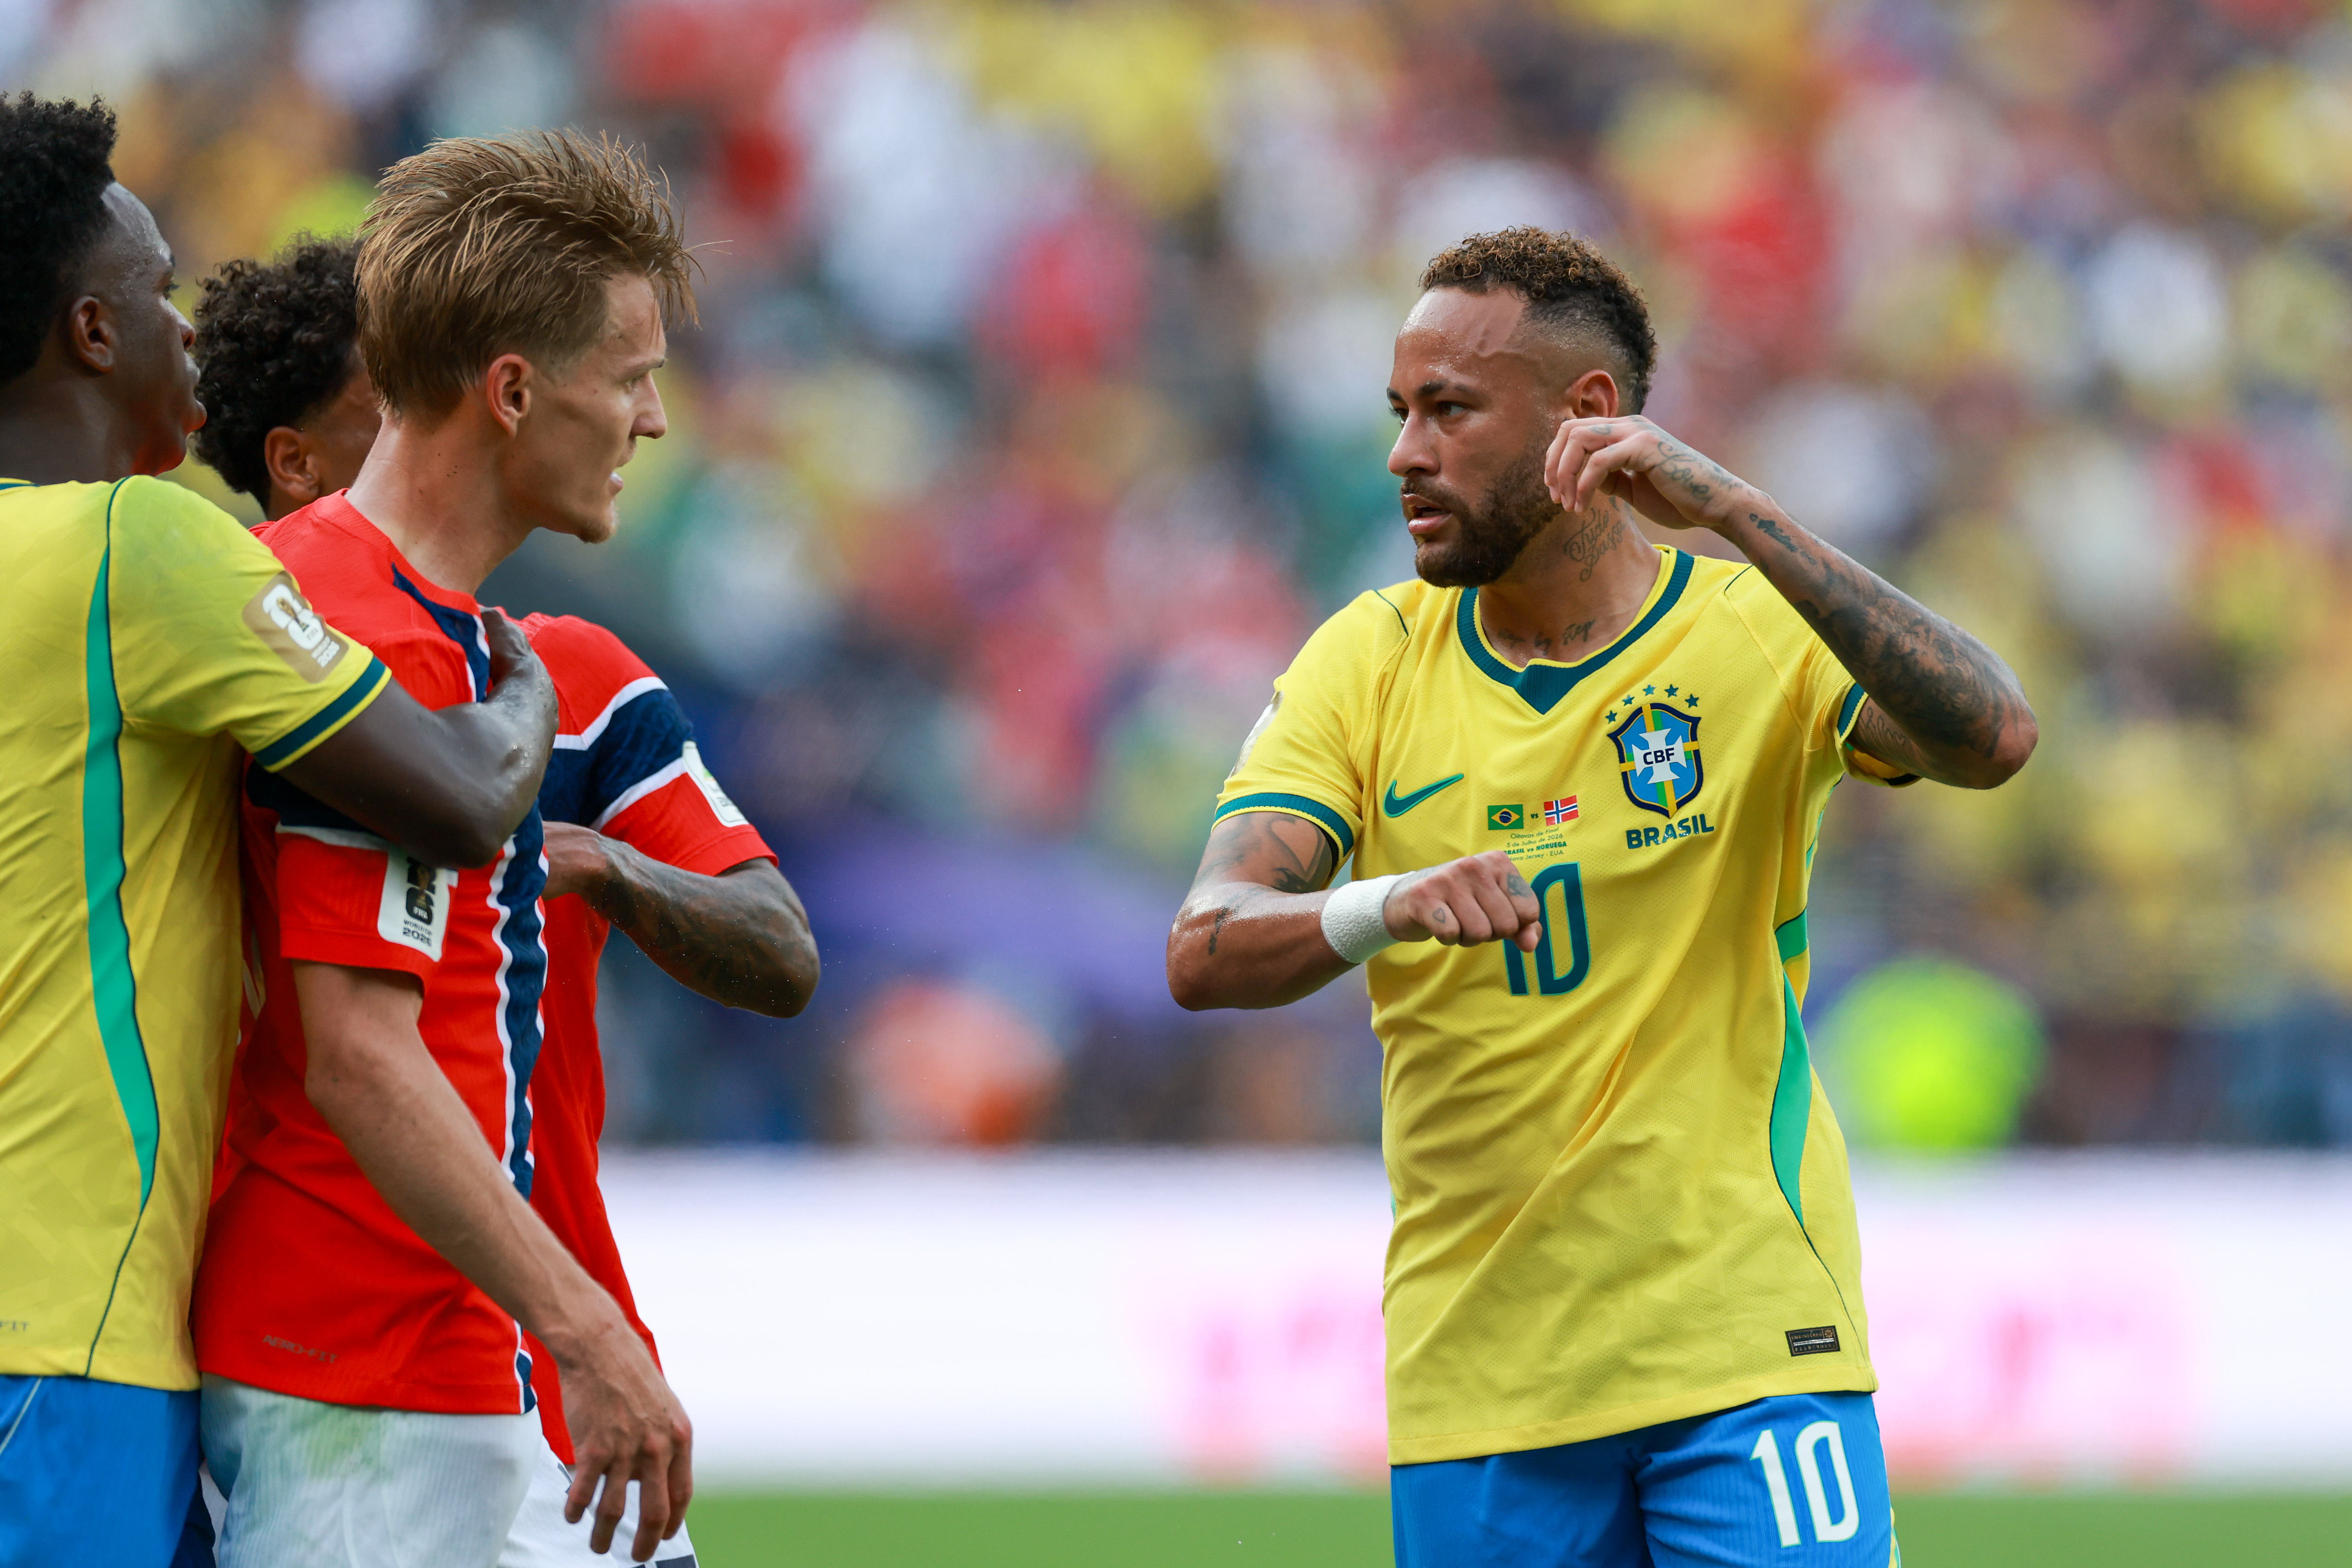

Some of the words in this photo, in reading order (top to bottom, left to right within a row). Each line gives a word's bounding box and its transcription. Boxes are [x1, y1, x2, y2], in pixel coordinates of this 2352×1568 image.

[1642, 747, 1675, 765] CBF
[1536, 841, 1567, 850] NORUEGA
[1626, 814, 1715, 850] BRASIL
[1750, 1419, 1860, 1549] 10
